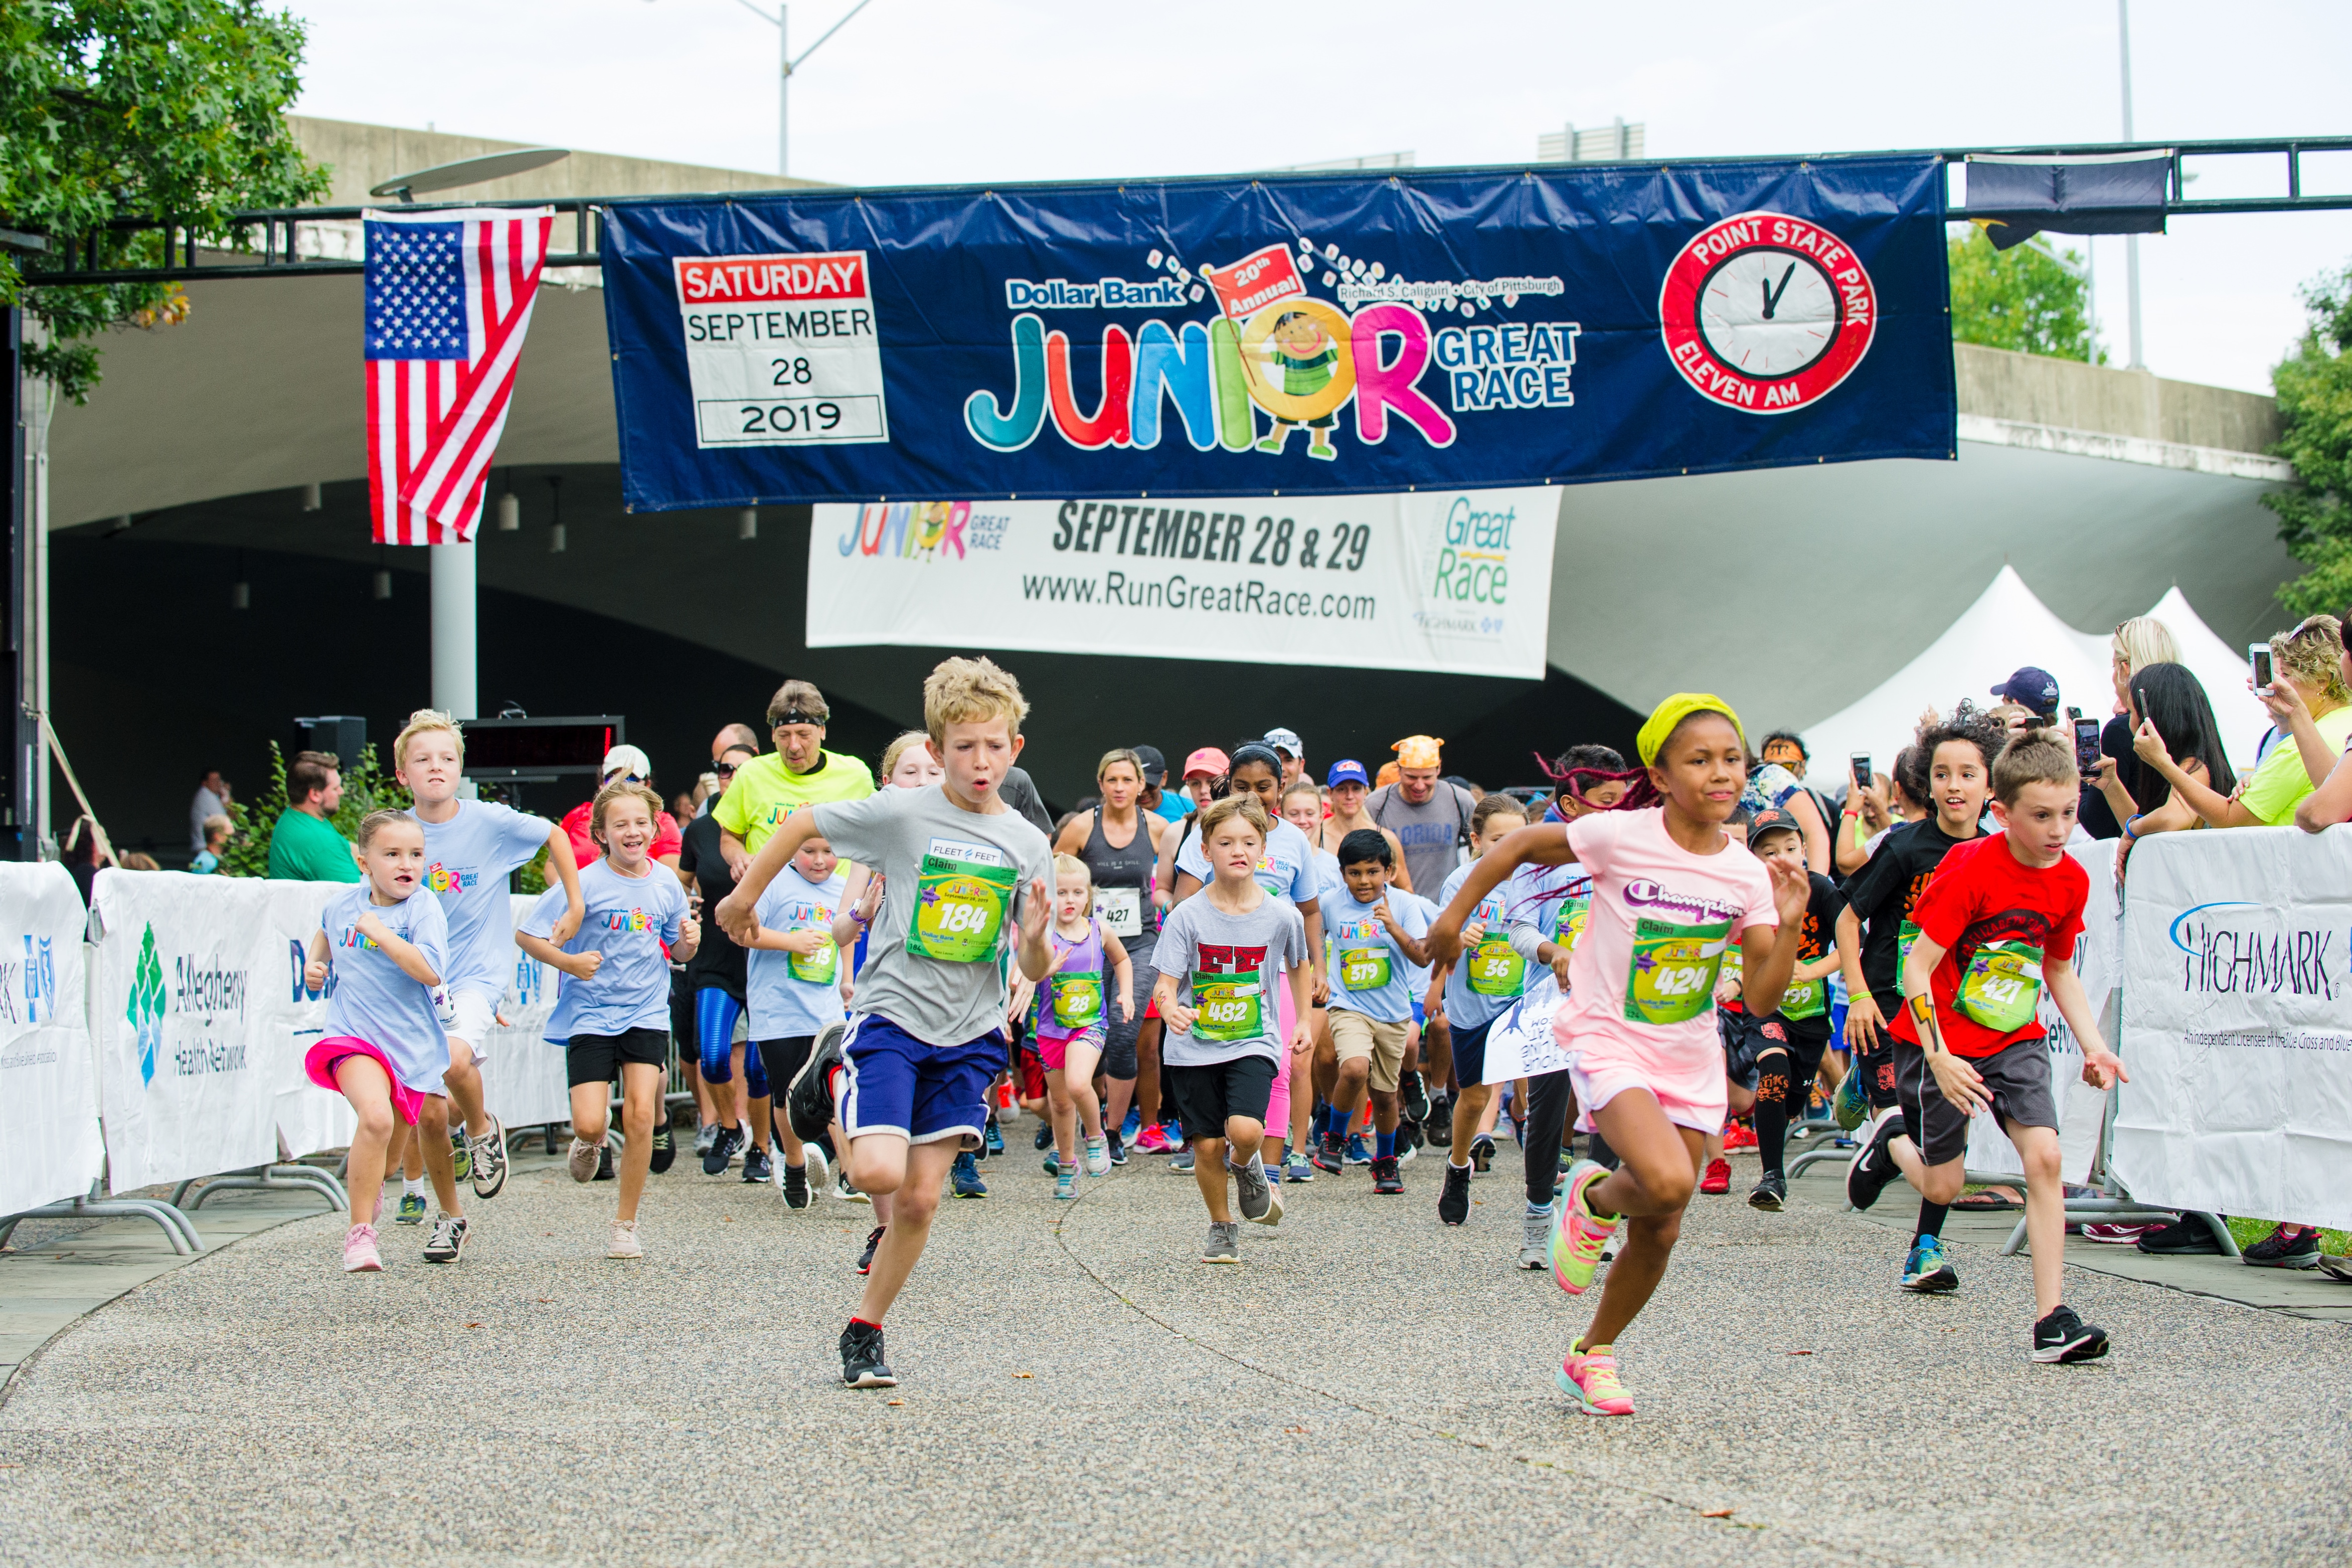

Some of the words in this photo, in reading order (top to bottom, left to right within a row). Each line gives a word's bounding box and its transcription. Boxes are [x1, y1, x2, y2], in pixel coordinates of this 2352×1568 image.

[687, 261, 858, 298] SATURDAY
[1234, 257, 1271, 288] 20th
[1692, 220, 1762, 266] POINT
[1772, 221, 1846, 269] STATE
[1836, 267, 1870, 327] PARK
[1009, 281, 1098, 306] Dollar
[1103, 280, 1185, 305] Bank
[1229, 272, 1298, 314] Annual
[1340, 287, 1384, 299] Richard
[1388, 287, 1399, 298] S.
[1463, 284, 1485, 298] City
[1487, 283, 1498, 294] of
[1502, 280, 1561, 293] Pittsburgh
[689, 309, 872, 341] SEPTEMBER
[1436, 325, 1579, 367] GREAT
[771, 357, 812, 386] 28
[965, 298, 1456, 450] JUNIOR
[1674, 340, 1755, 406] ELEVEN
[1763, 382, 1801, 407] AM
[1454, 367, 1572, 408] RACE
[740, 403, 842, 433] 2019
[838, 501, 972, 561] JUNIOR
[970, 515, 1011, 532] GREAT
[1446, 496, 1516, 550] Great
[968, 532, 1002, 551] RACE
[1053, 500, 1246, 563] SEPTEMBER
[1249, 516, 1295, 567] 28
[1299, 528, 1319, 569] &
[1326, 522, 1371, 572] 29
[1434, 547, 1507, 604] Race
[1023, 571, 1376, 621] www.RunGreatRace.com
[1392, 822, 1453, 846] ORIDA
[928, 857, 957, 871] Claim
[933, 846, 963, 856] FLEET
[974, 851, 996, 862] FEET
[421, 871, 463, 894] IOR
[461, 873, 479, 881] GREAT
[462, 880, 477, 888] RACE
[1563, 900, 1584, 909] Claim
[1625, 879, 1745, 919] Champion
[601, 913, 652, 934] JUNIOR
[789, 905, 832, 925] JUNIOR
[938, 903, 988, 934] 184
[1470, 903, 1504, 923] JUNI
[340, 927, 379, 951] JUNI
[922, 931, 938, 939] Dollar
[1337, 924, 1380, 940] JUNIOR
[1641, 920, 1674, 935] Claim
[909, 943, 921, 951] 184
[1484, 958, 1510, 977] 36
[2185, 922, 2332, 1001] HIGHMARK
[1195, 972, 1214, 981] Claim
[1654, 965, 1710, 996] 424
[175, 953, 247, 1027] Allegheny
[1067, 995, 1090, 1013] 28
[1208, 1002, 1248, 1022] 482
[2236, 1030, 2266, 1048] Licensee
[2266, 1030, 2274, 1048] of
[2298, 1032, 2318, 1050] Cross
[2319, 1034, 2334, 1051] and
[2335, 1034, 2352, 1052] Blue
[175, 1036, 210, 1077] Health
[209, 1037, 247, 1073] Netwok
